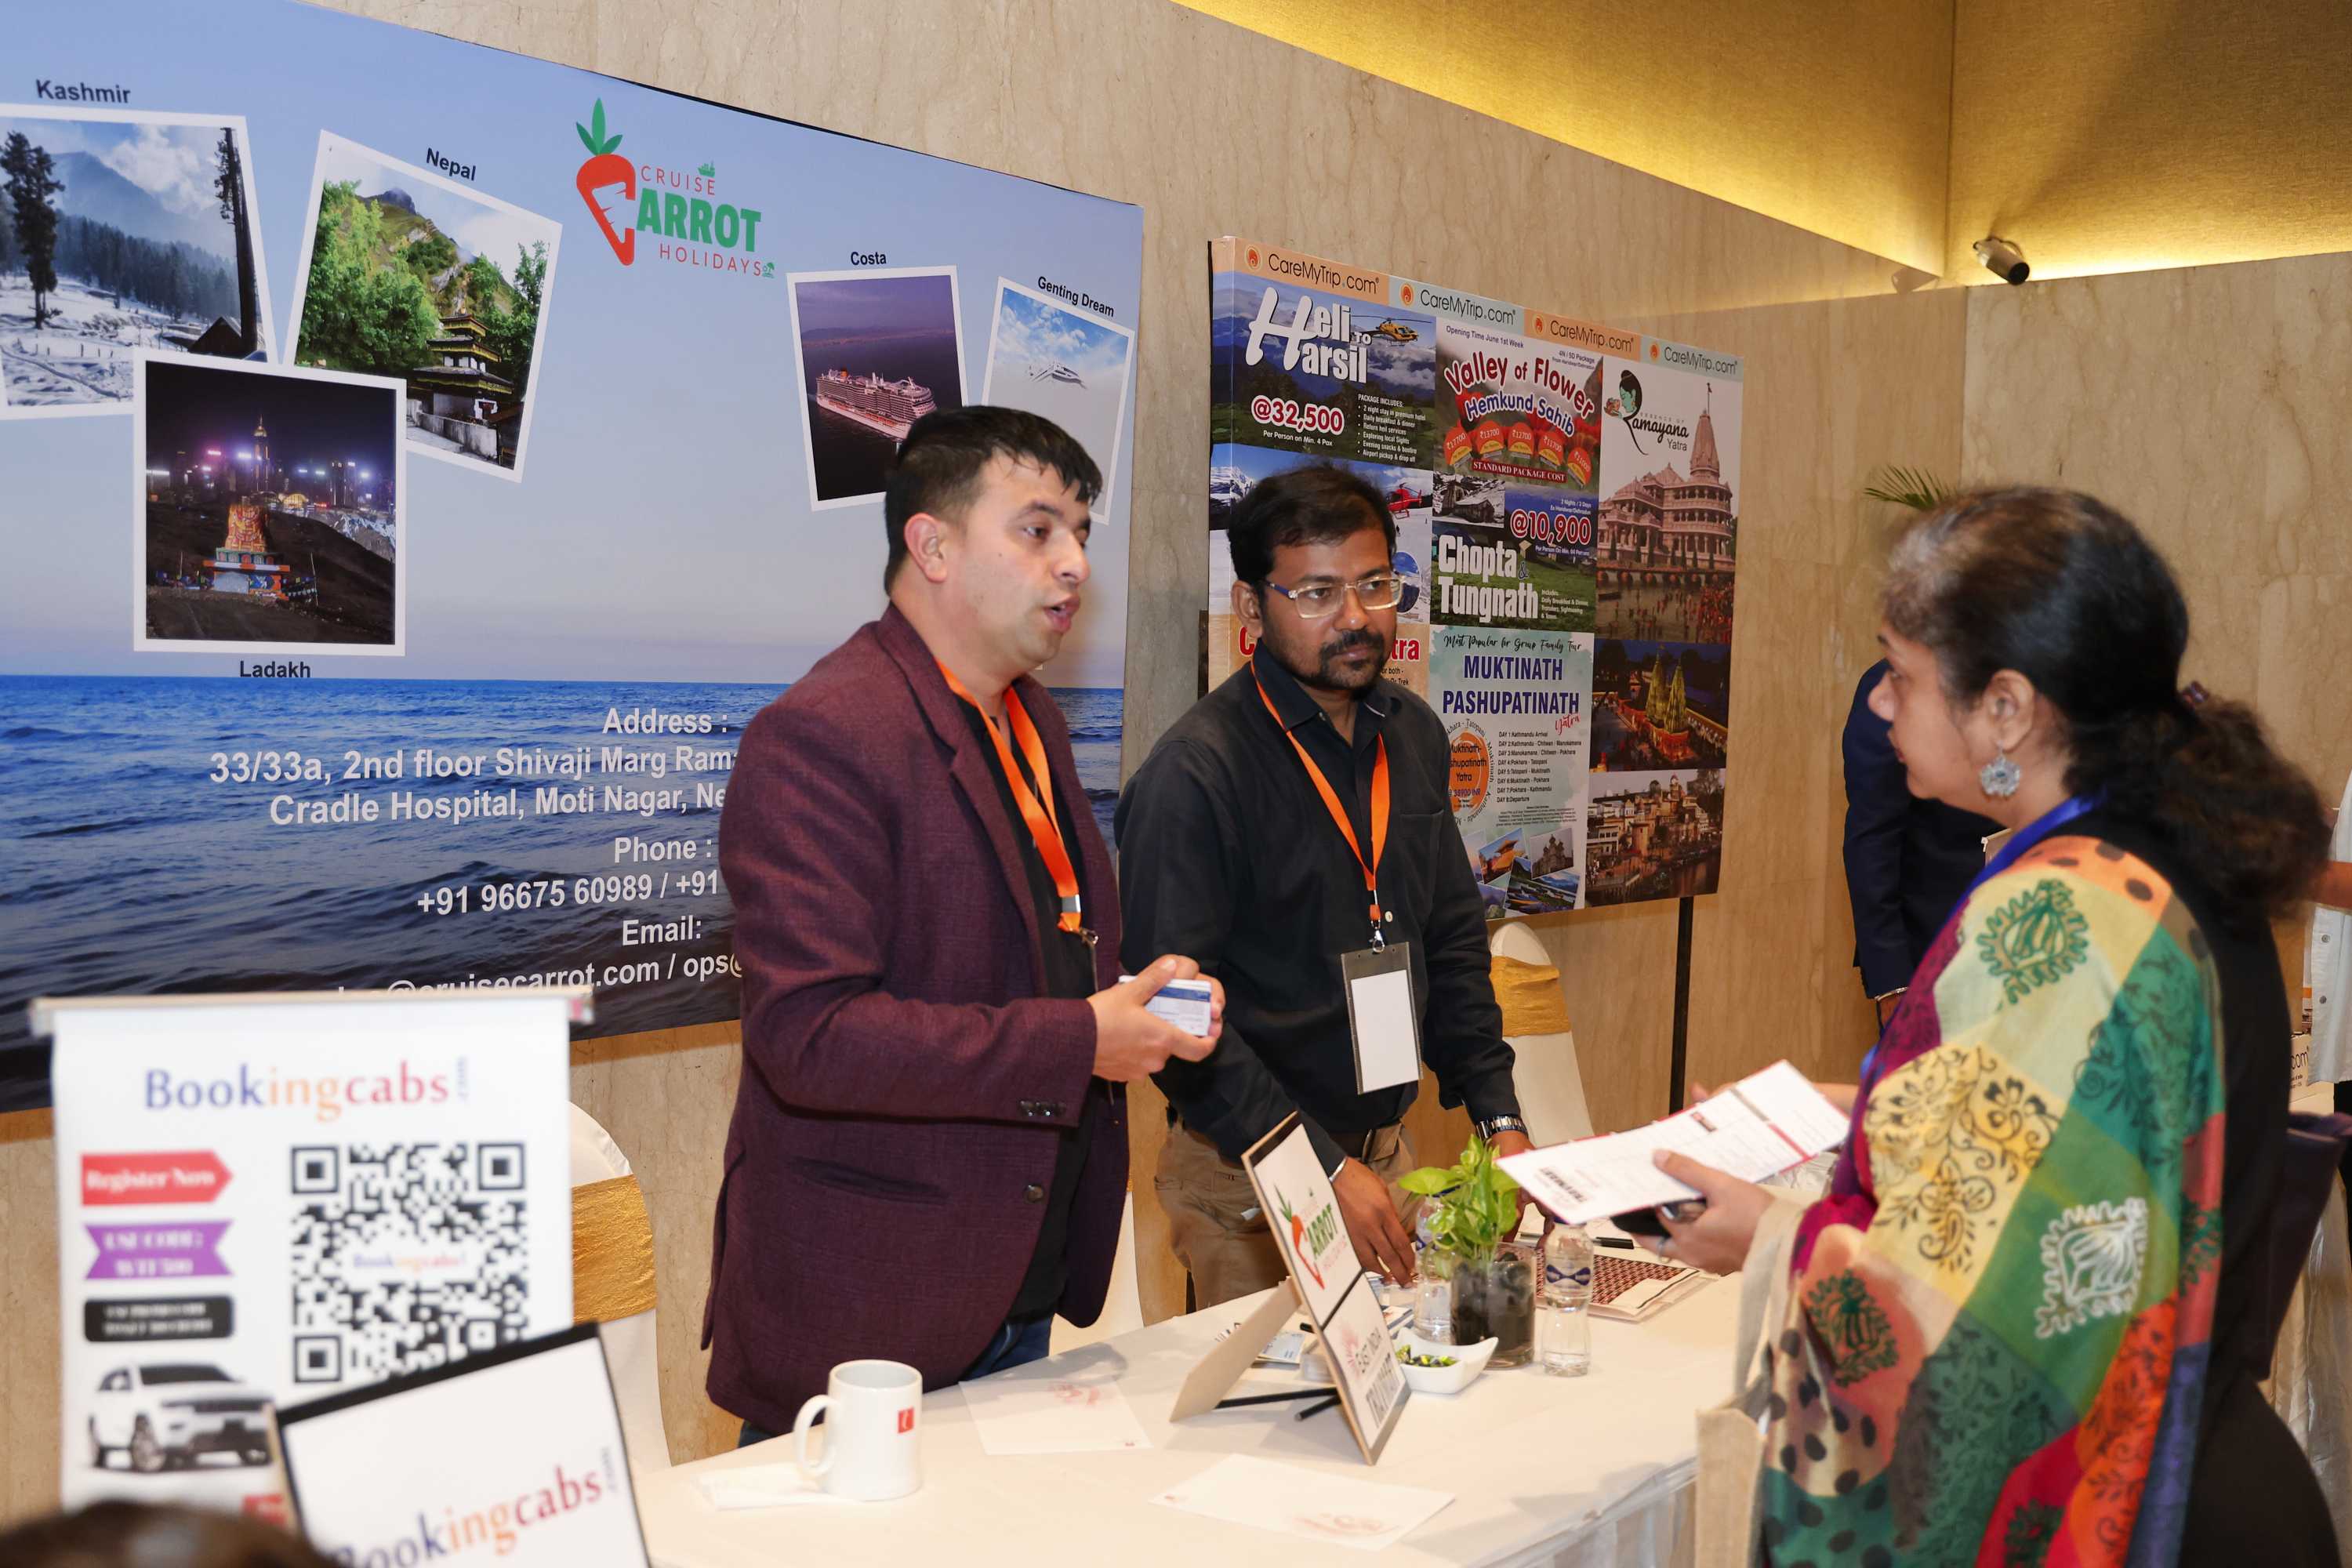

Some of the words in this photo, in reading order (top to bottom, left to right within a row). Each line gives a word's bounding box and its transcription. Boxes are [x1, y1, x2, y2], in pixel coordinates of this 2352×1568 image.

[36, 80, 131, 104] Kashmir
[426, 147, 477, 182] Nepal
[641, 165, 715, 196] CRUISE
[660, 243, 761, 276] HOLIDAYS
[850, 251, 887, 266] Costa
[1038, 276, 1079, 306] Genting
[1082, 293, 1114, 317] Dream
[1446, 325, 1470, 339] Opening
[1472, 331, 1485, 340] Time
[1486, 334, 1498, 343] June
[1509, 339, 1524, 348] Week
[1445, 351, 1508, 395] Valley
[1515, 361, 1528, 380] of
[1534, 357, 1595, 419] Flower
[1358, 394, 1380, 404] PACKAGE
[1381, 397, 1404, 407] INCLUDES:
[1368, 406, 1379, 415] night
[1465, 390, 1534, 421] Hemkund
[1537, 397, 1575, 437] Sahib
[1251, 394, 1344, 435] @32,500
[1274, 432, 1294, 441] Person
[1668, 438, 1687, 451] Yatra
[1473, 461, 1512, 474] STANDARD
[1513, 467, 1545, 479] PACKAGE
[1547, 472, 1566, 481] COST
[1510, 509, 1592, 546] @10,900
[1438, 535, 1517, 583] Chopta
[1438, 576, 1538, 622] Tungnath
[1392, 639, 1420, 662] tra
[1444, 634, 1466, 648] Most
[1468, 636, 1498, 649] Popular
[1501, 637, 1509, 648] for
[1515, 637, 1536, 652] Group
[1541, 638, 1564, 654] Family
[1568, 640, 1581, 652] Tour
[239, 660, 311, 679] Ladakh
[1465, 655, 1563, 681] MUKTINATH
[1443, 691, 1580, 714] PASHUPATINATH
[603, 708, 712, 734] Address
[1446, 722, 1461, 735] khara
[209, 750, 332, 786] 33/33a,
[343, 750, 404, 780] 2nd
[414, 750, 486, 778] floor
[495, 747, 591, 780] Shivaji
[601, 746, 666, 779] Marg
[675, 746, 738, 771] Ram
[1450, 759, 1487, 769] shupatinath
[1456, 772, 1472, 782] Yatra
[270, 793, 380, 826] Cradle
[392, 789, 524, 825] Hospital,
[535, 786, 595, 815] Moti
[604, 785, 689, 816] Nagar,
[696, 782, 726, 808] Ne
[614, 837, 698, 863] Phone
[417, 885, 470, 916] +91
[481, 880, 565, 913] 96675
[574, 875, 653, 906] 60989
[659, 873, 668, 898] /
[675, 871, 719, 896] +91
[622, 916, 702, 946] Email:
[667, 953, 676, 979] /
[144, 1062, 449, 1122] Bookingcabs
